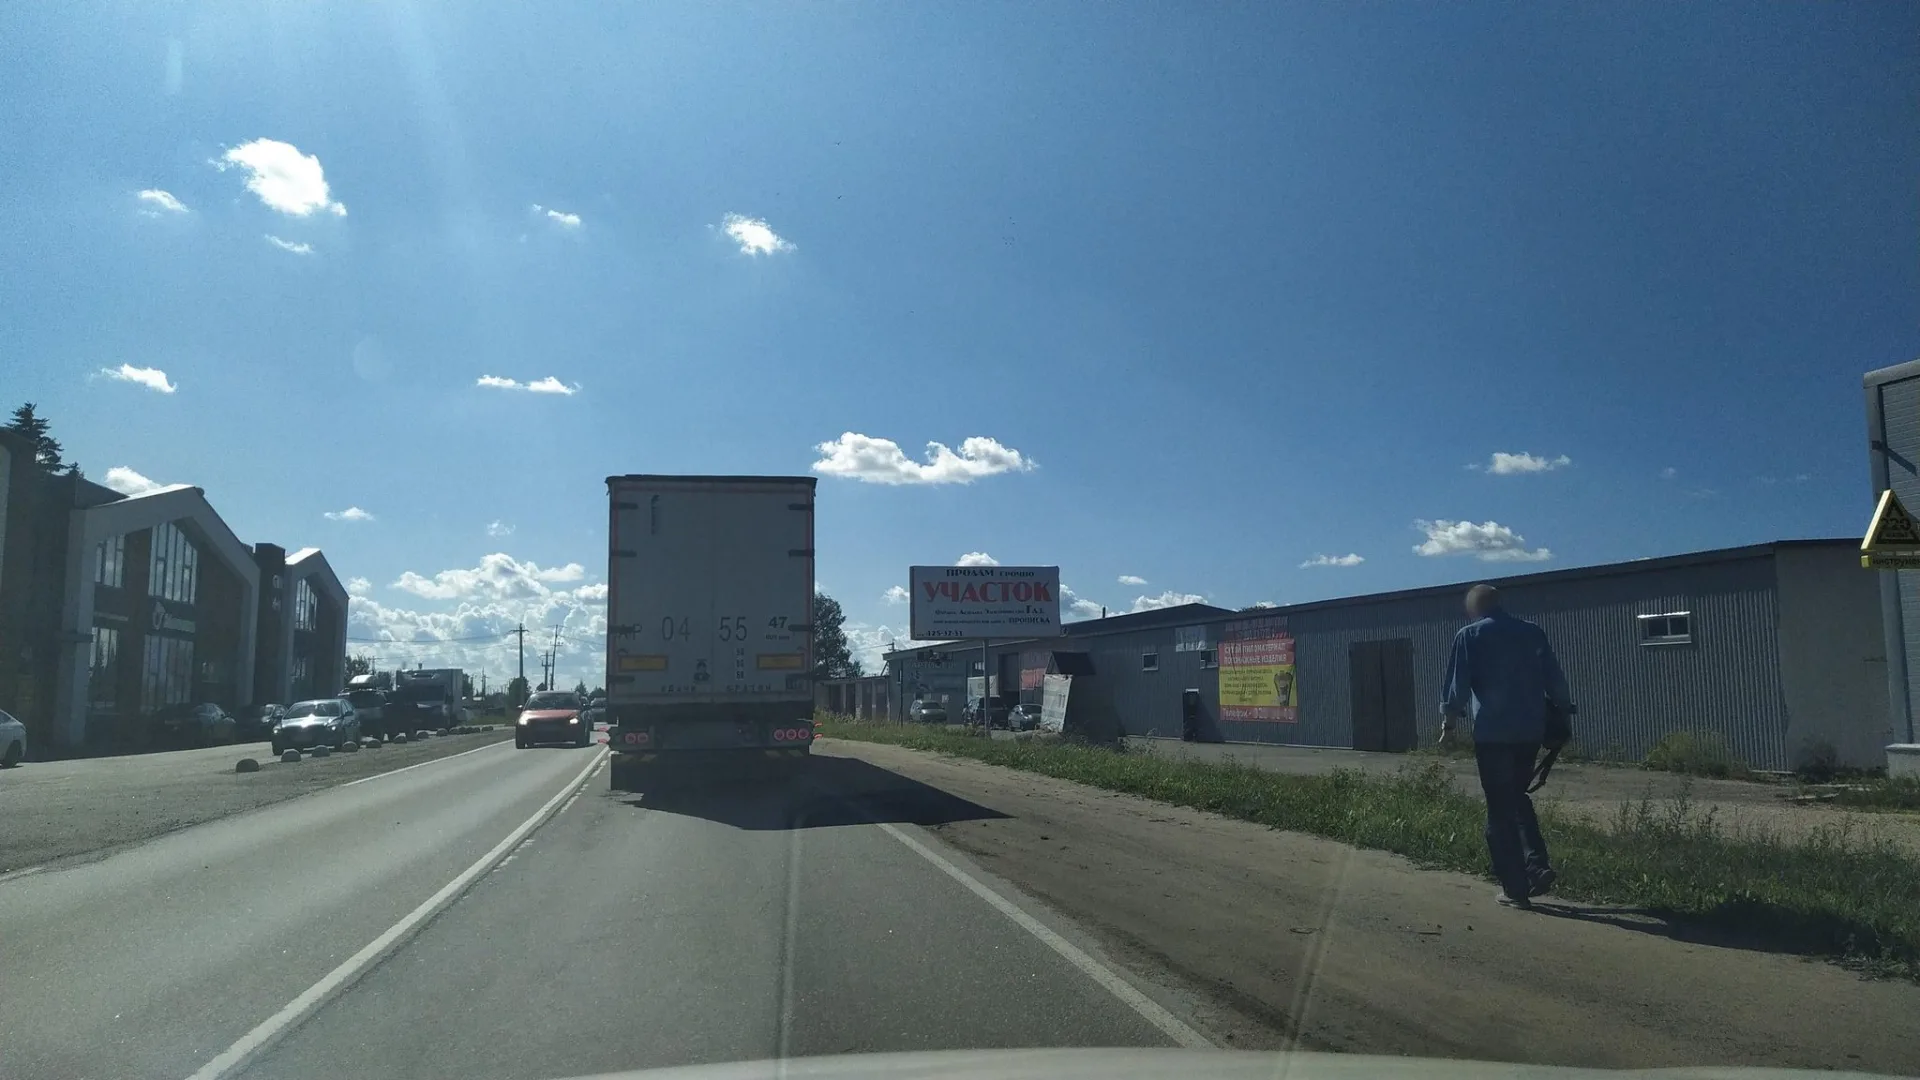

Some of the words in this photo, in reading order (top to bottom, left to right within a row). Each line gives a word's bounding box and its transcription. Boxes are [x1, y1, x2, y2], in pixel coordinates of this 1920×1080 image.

[922, 581, 1053, 603] УЧАСТОК
[661, 616, 691, 642] 04
[718, 616, 748, 642] 55
[768, 616, 788, 629] 47
